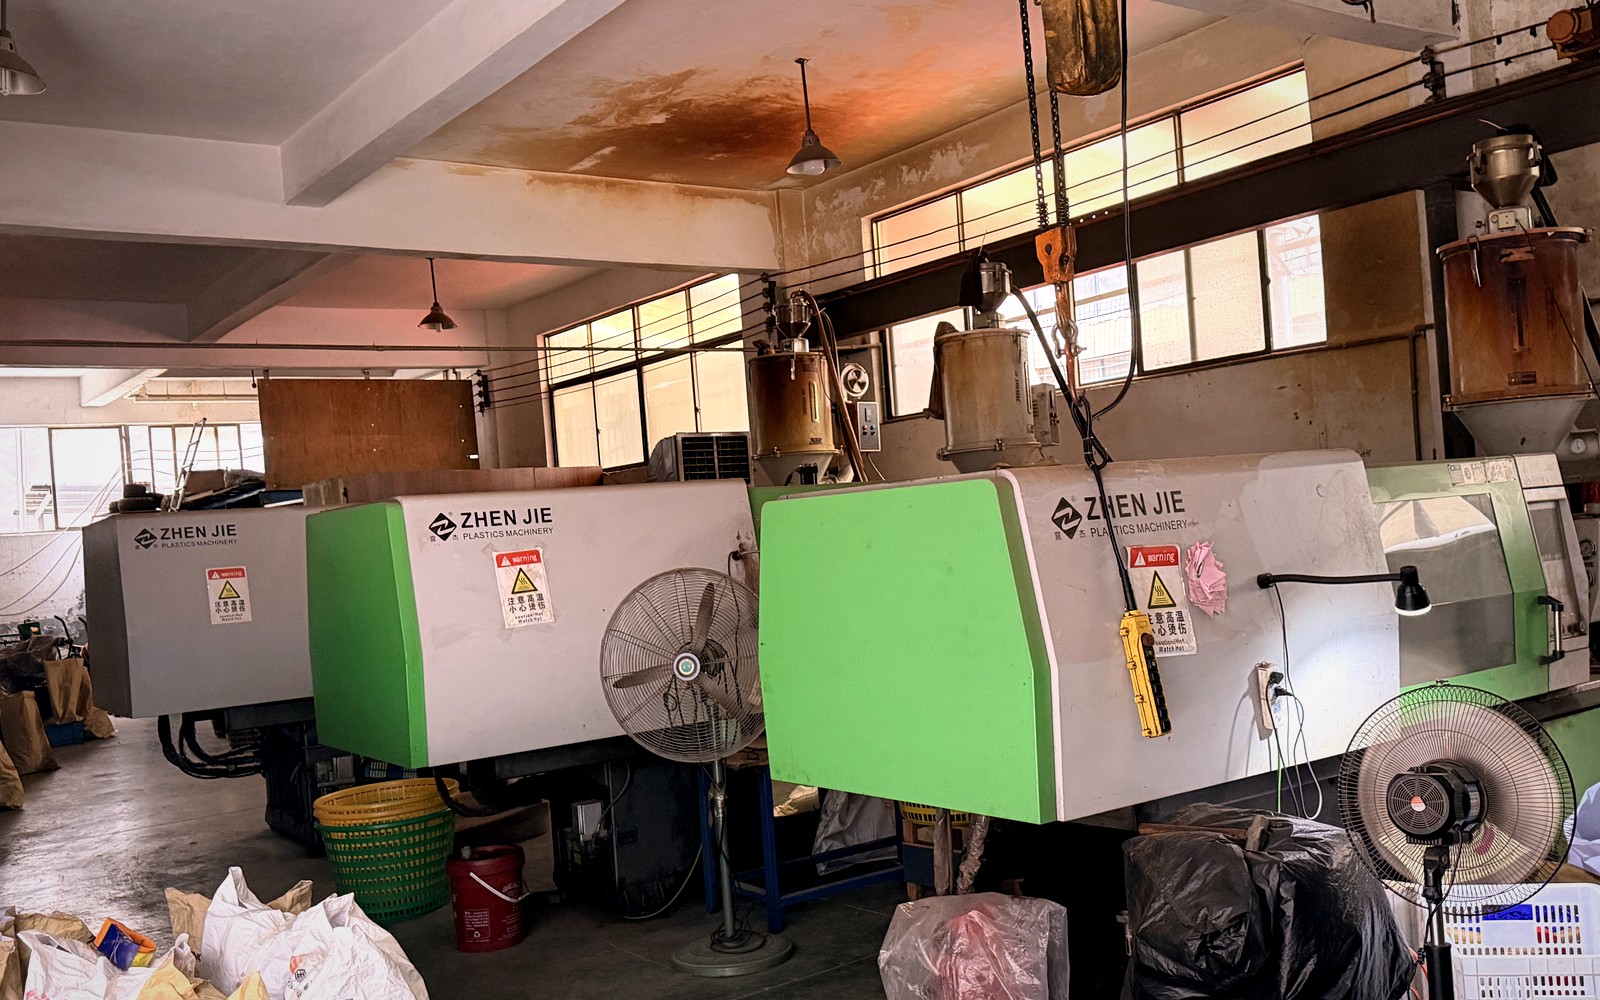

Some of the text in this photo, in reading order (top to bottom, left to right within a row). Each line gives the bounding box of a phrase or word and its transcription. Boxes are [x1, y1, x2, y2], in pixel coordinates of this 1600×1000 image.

[1084, 490, 1185, 520] ZHEN JIE
[460, 507, 553, 528] ZHEN JIE
[160, 524, 237, 540] ZHEN JIE
[463, 527, 554, 540] PLASTICS MACHINERY
[1090, 519, 1188, 538] PLATICS MACHINERY
[161, 541, 196, 549] PLASTICS
[197, 538, 238, 547] MACHINERY
[512, 553, 538, 563] warning
[1147, 550, 1175, 563] warning
[507, 593, 544, 606] 注意高温
[509, 601, 546, 613] 小心烫伤
[1151, 623, 1187, 636] 心烫伤
